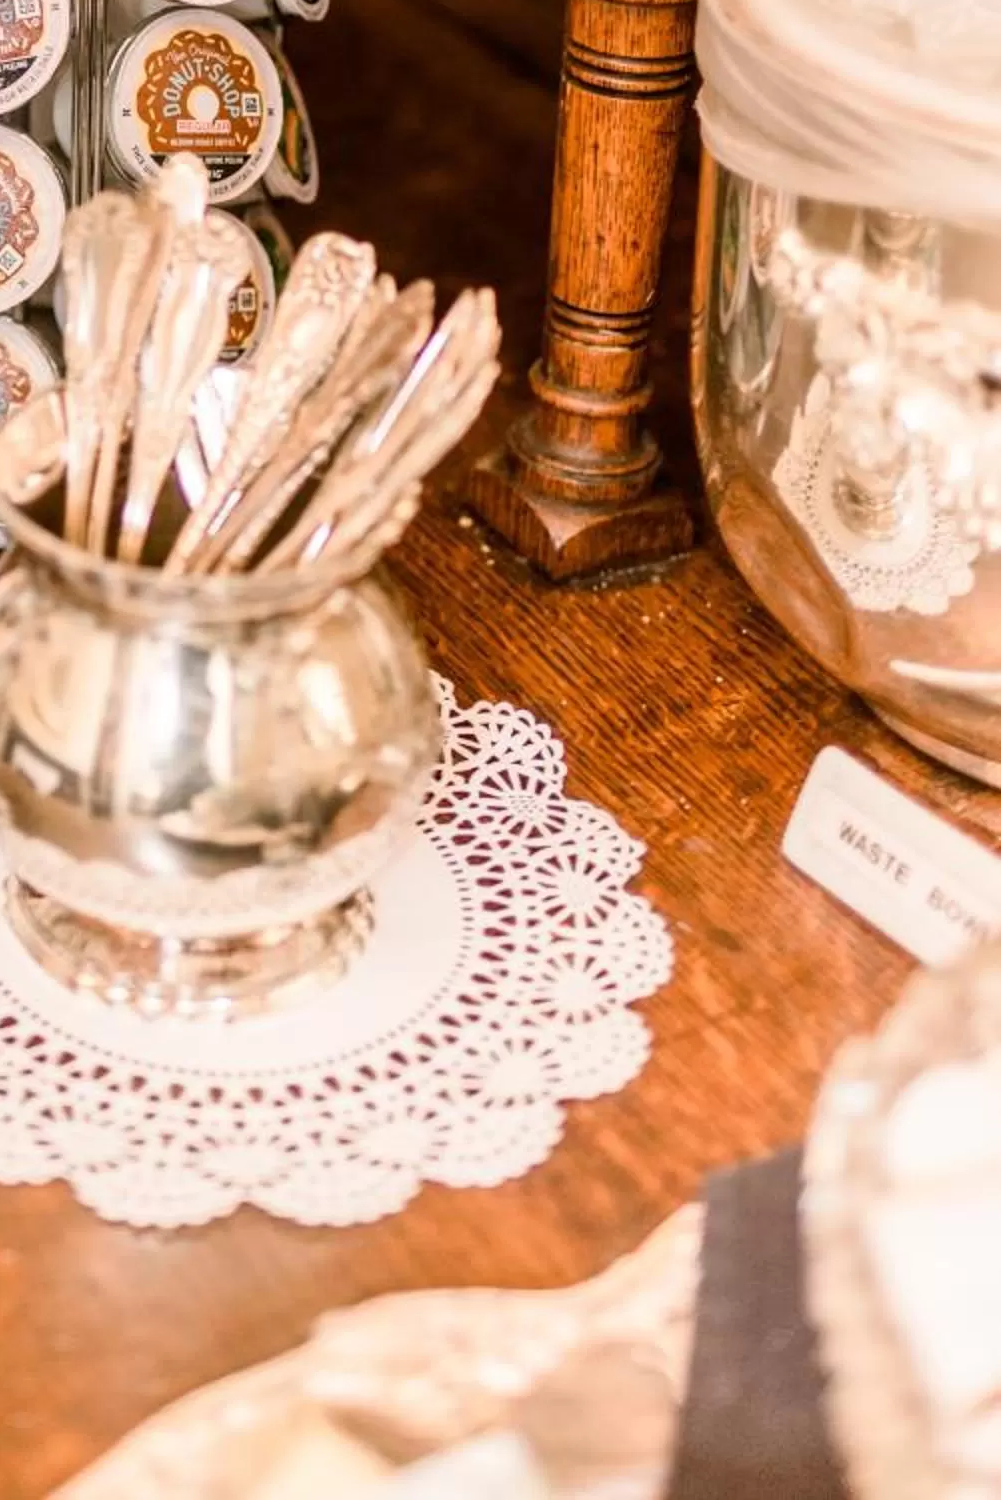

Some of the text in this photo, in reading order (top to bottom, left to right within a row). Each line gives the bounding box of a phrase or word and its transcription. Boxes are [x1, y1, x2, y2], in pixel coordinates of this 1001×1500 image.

[188, 45, 232, 65] Original
[163, 58, 240, 118] DONUT SHOP
[839, 820, 911, 885] WASTE
